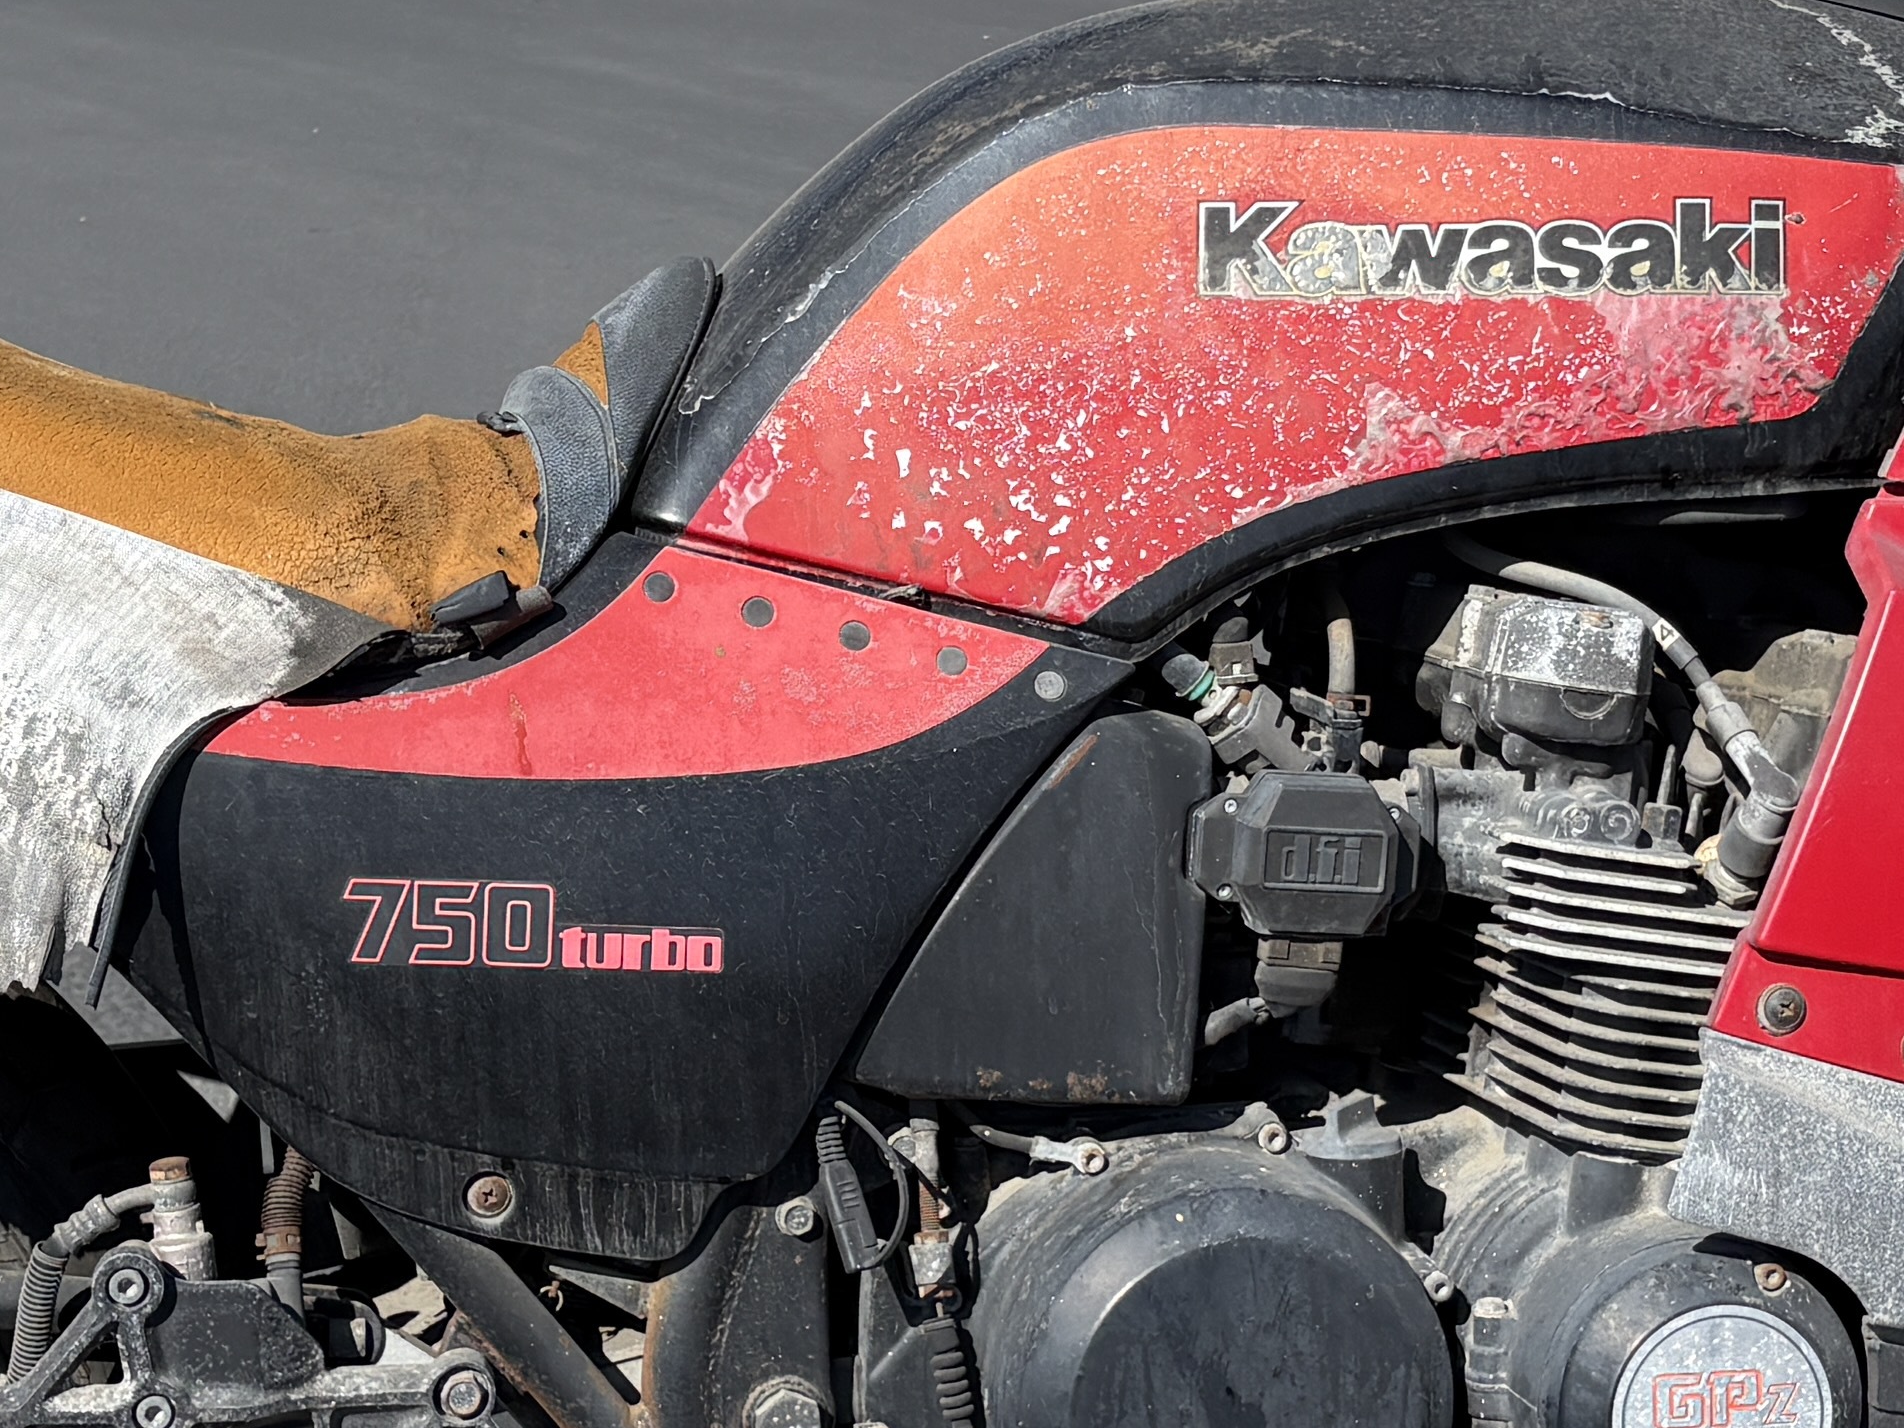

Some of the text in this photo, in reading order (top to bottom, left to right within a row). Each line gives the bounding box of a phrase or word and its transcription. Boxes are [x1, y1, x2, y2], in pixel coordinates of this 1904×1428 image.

[1197, 198, 1787, 298] Kawasaki
[1660, 623, 1675, 641] 4
[342, 876, 723, 973] 750 turbo
